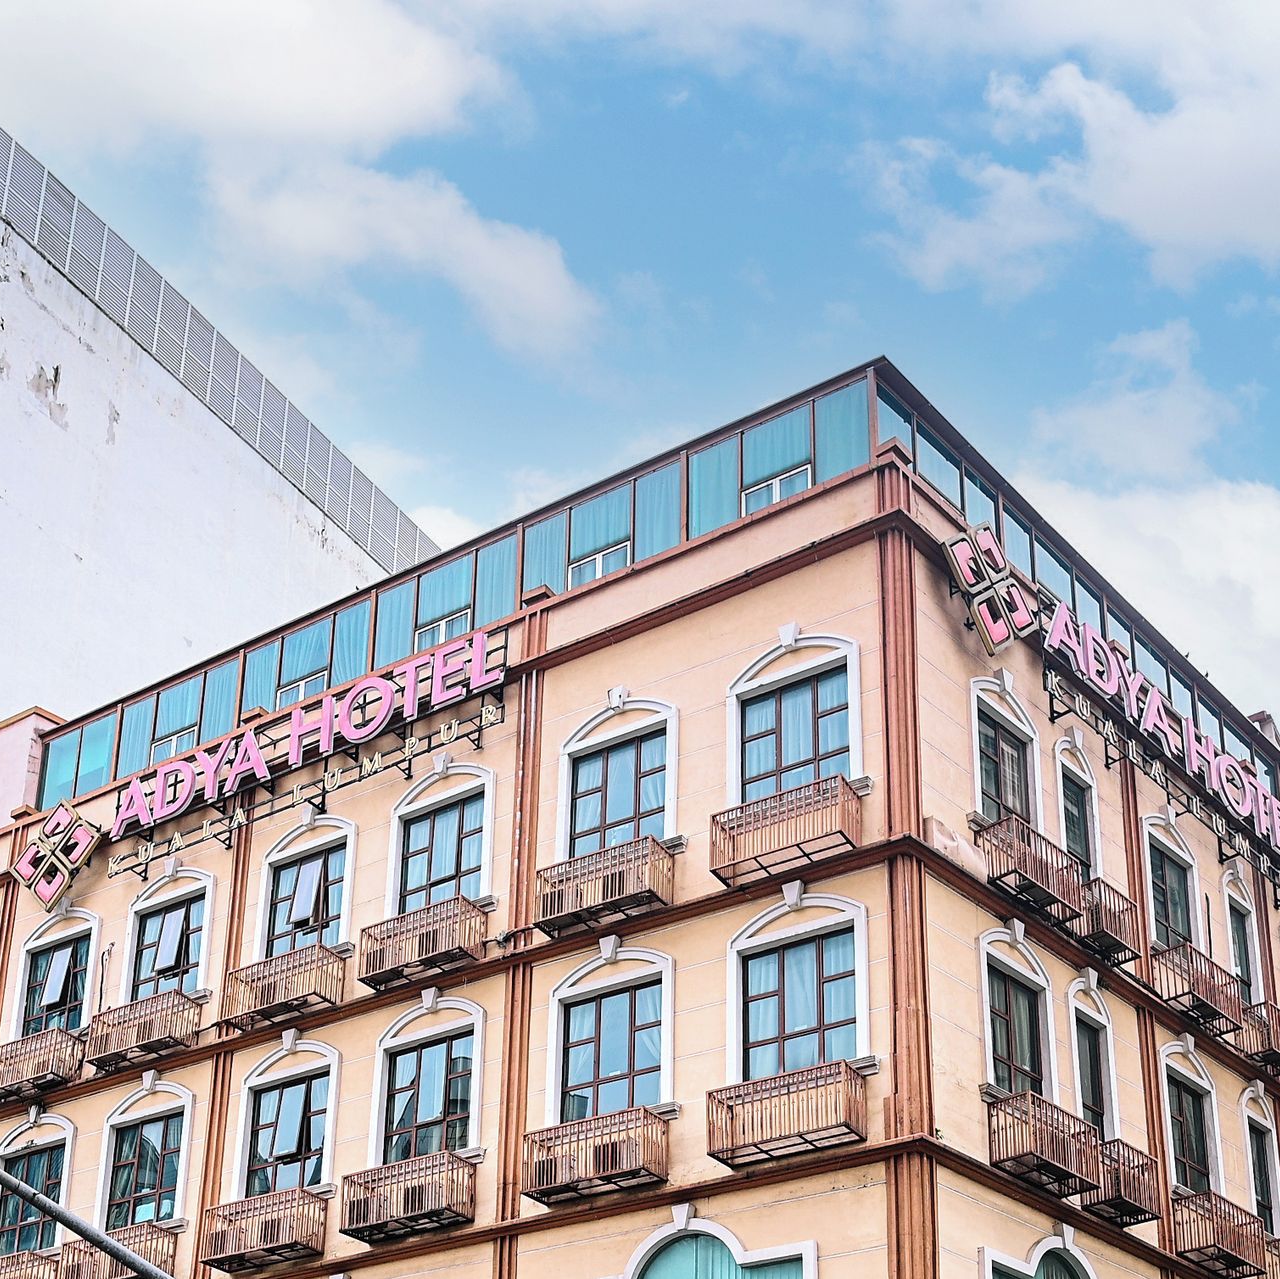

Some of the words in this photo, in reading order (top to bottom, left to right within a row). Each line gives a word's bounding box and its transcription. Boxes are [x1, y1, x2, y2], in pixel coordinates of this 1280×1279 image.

[108, 728, 272, 843] ADYA
[288, 630, 506, 770] HOTEL
[1043, 600, 1183, 758] ADYA
[1044, 669, 1168, 786] KUALA
[106, 806, 249, 879] KUALA
[291, 703, 506, 806] LUMPUR
